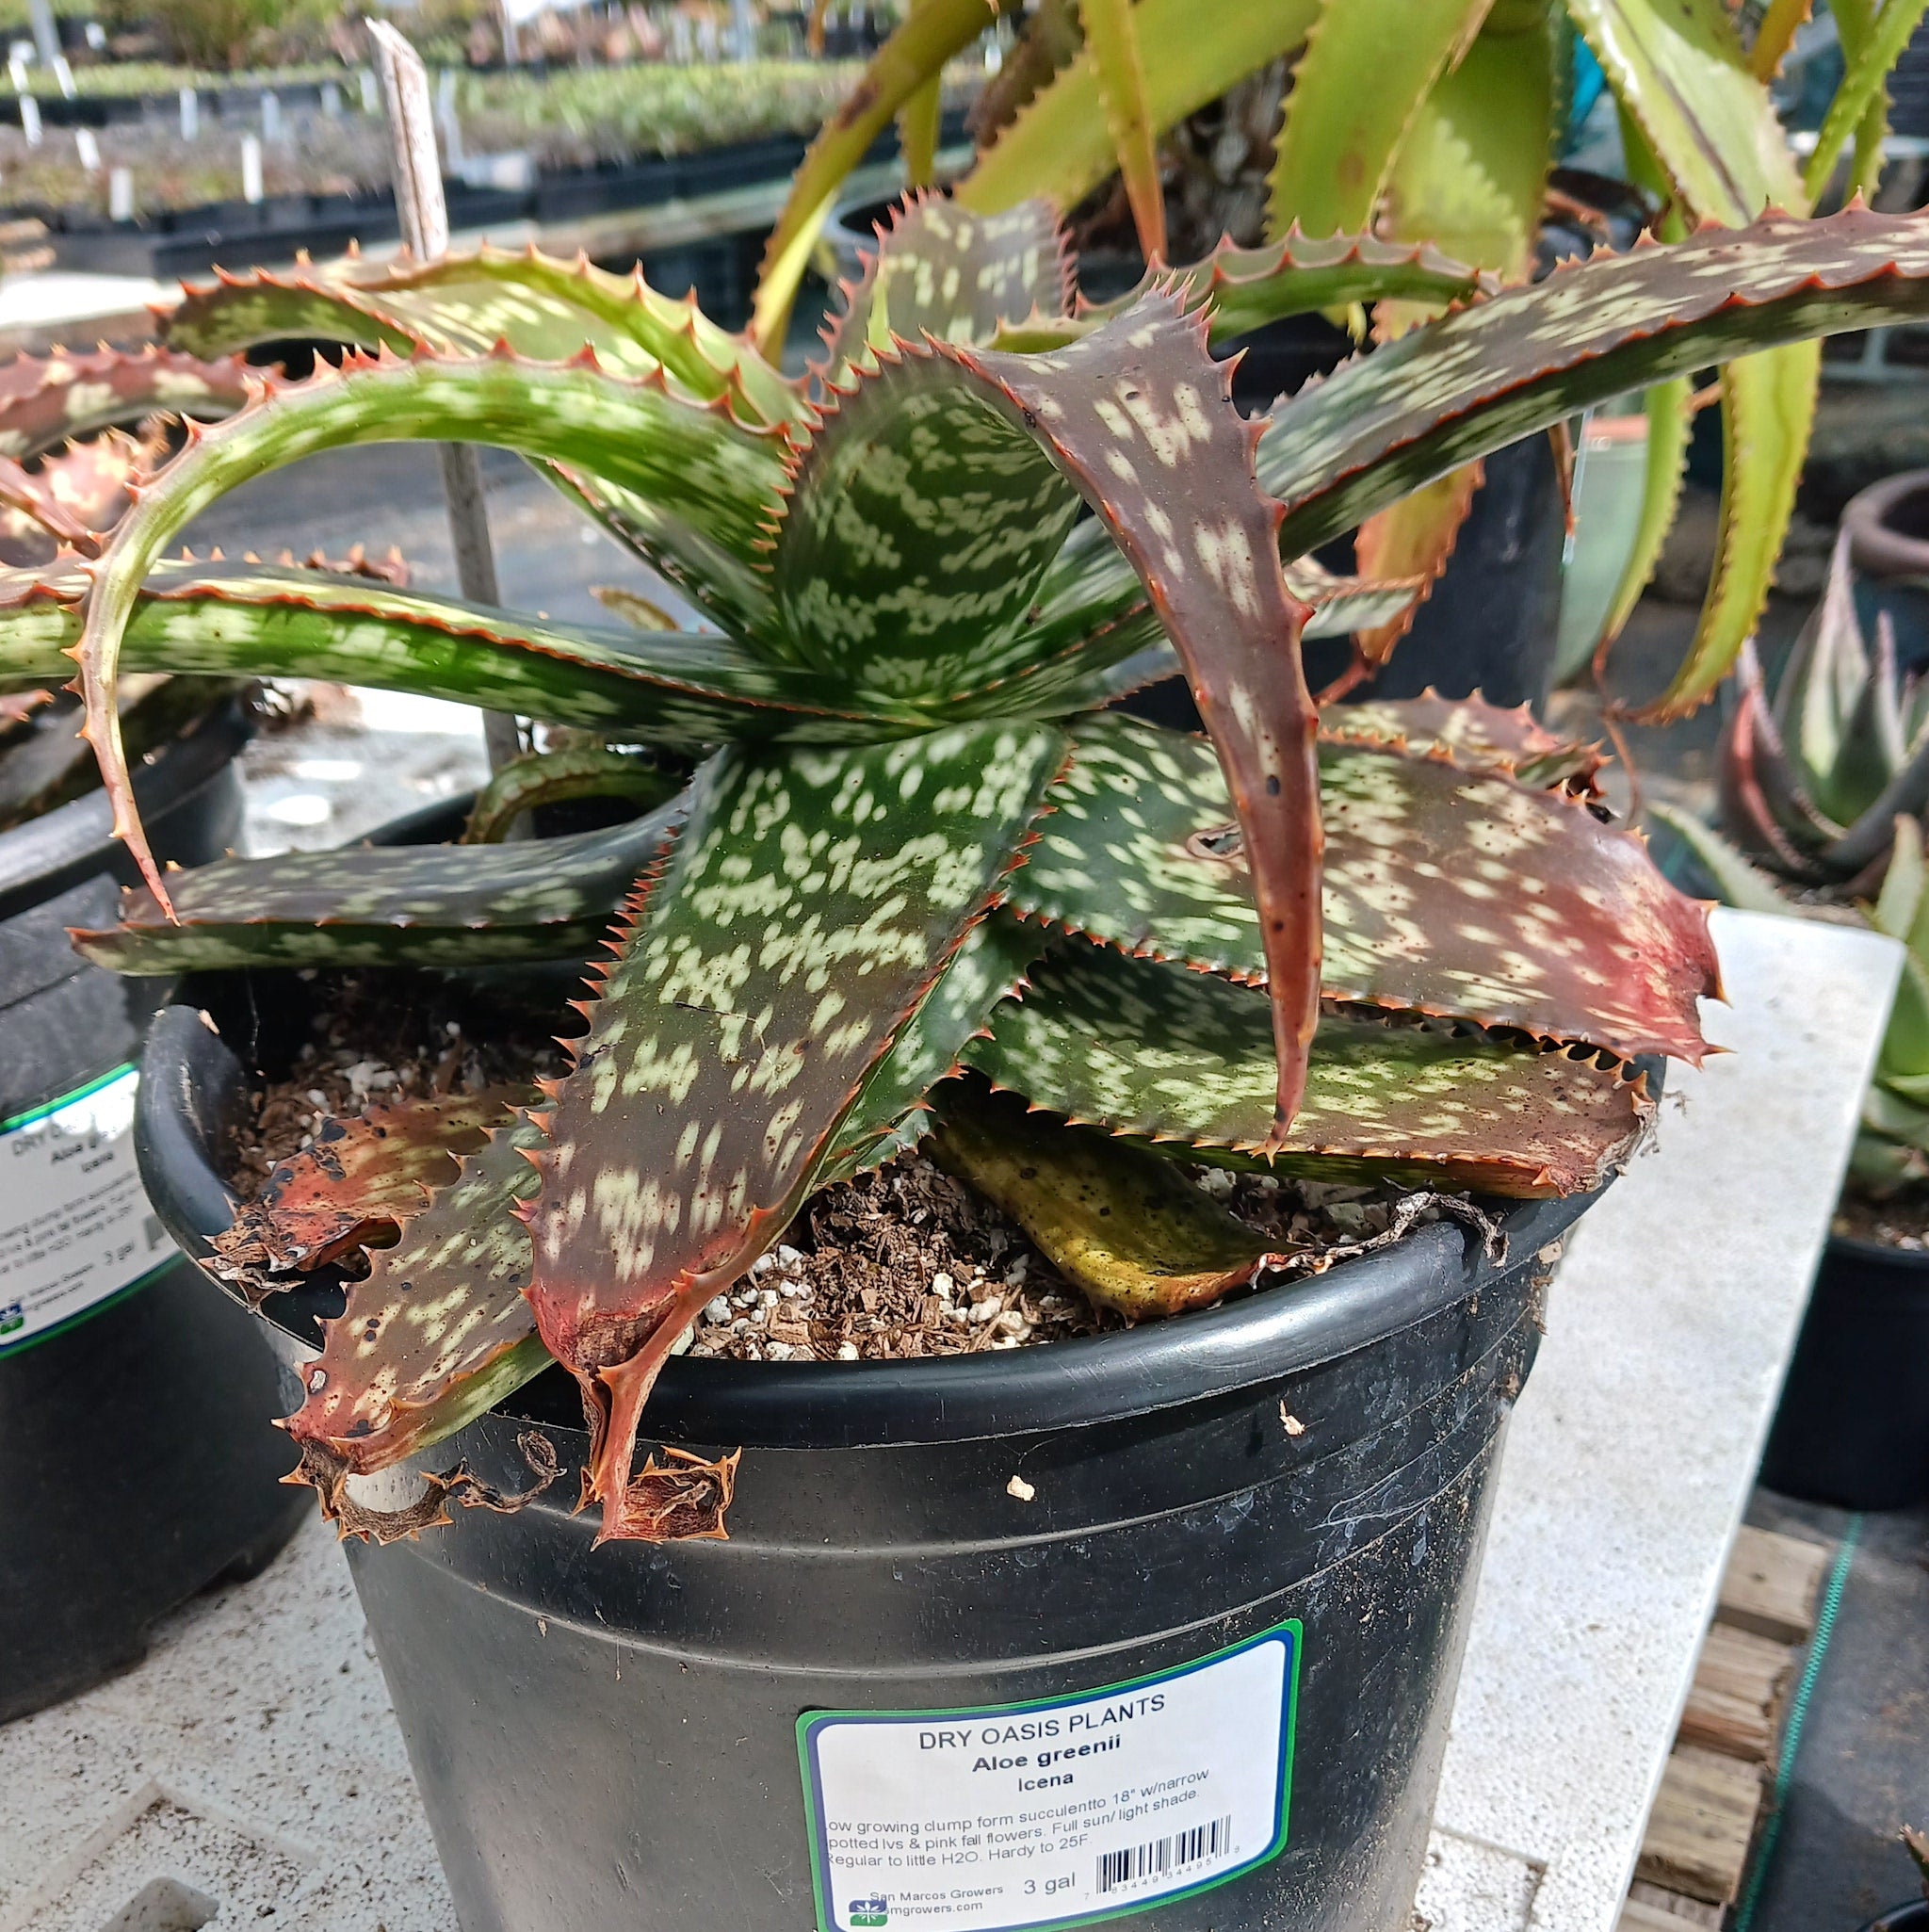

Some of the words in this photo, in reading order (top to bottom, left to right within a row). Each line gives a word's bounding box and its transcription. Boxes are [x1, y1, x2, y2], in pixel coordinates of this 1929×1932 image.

[919, 1729, 972, 1749] DRY
[981, 1719, 1060, 1745] OASIS
[1069, 1694, 1166, 1733] PLANTS
[972, 1755, 1028, 1772] Aloe
[1037, 1734, 1121, 1767] greenii
[1018, 1773, 1074, 1792] Icena
[827, 1820, 851, 1832] ow
[857, 1820, 919, 1835] growing
[924, 1819, 972, 1832] clump
[977, 1814, 1013, 1829] form
[1112, 1787, 1136, 1805] 18"
[1141, 1768, 1209, 1797] w/narrow
[828, 1837, 878, 1852] potted
[909, 1837, 920, 1849] &
[926, 1834, 957, 1852] pink
[962, 1834, 981, 1846] fall
[987, 1826, 1046, 1845] flowers.
[1053, 1819, 1078, 1835] Full
[1153, 1788, 1200, 1811] shade.
[888, 1855, 902, 1867] to
[906, 1853, 936, 1867] little
[988, 1841, 1035, 1861] Hardy
[1040, 1843, 1054, 1854] to
[869, 1891, 896, 1902] San
[900, 1890, 946, 1901] Marcos
[950, 1886, 1004, 1899] Growers
[1024, 1879, 1036, 1895] 3
[1045, 1872, 1076, 1895] gal
